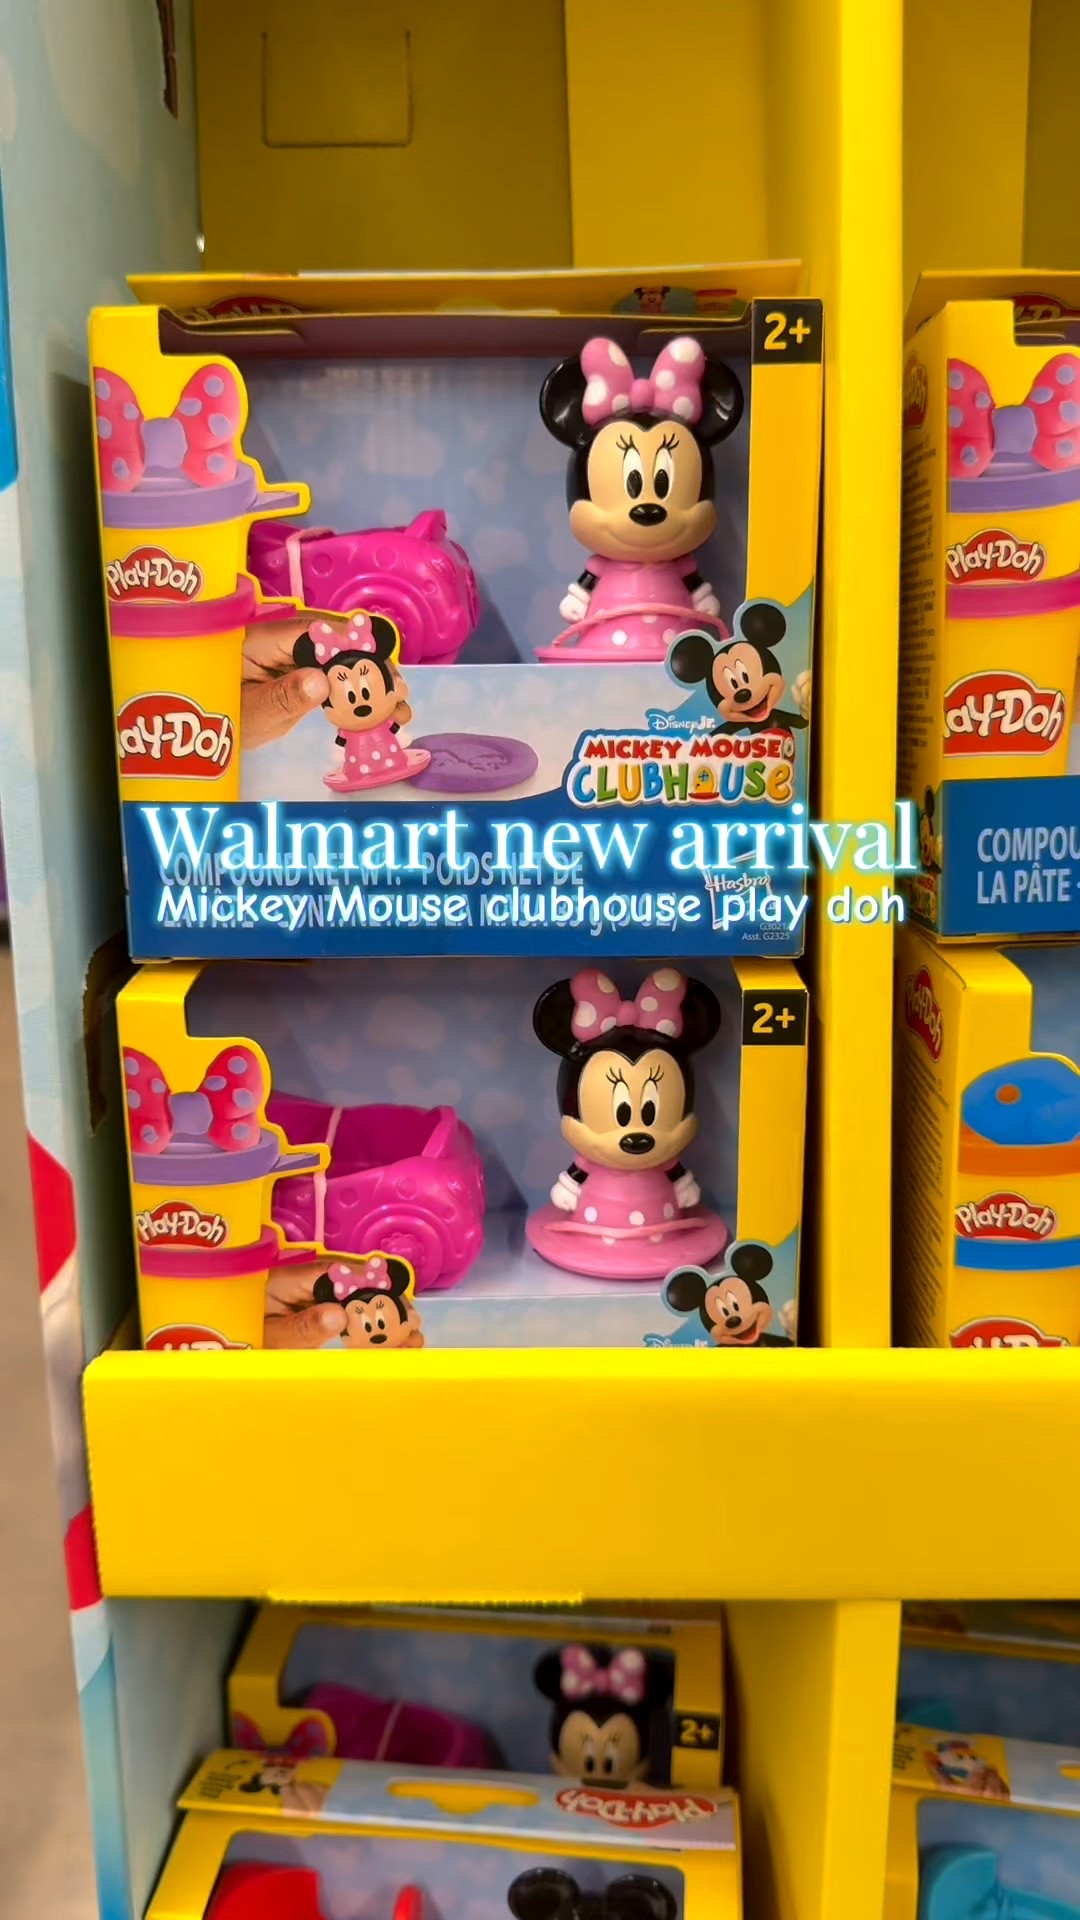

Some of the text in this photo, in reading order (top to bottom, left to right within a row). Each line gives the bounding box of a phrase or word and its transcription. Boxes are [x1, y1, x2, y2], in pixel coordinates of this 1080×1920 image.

[764, 311, 811, 350] 2+
[107, 557, 198, 596] Play-Doh
[946, 542, 1041, 579] Play-Doh
[649, 713, 698, 734] Disney
[944, 688, 1063, 742] ay-Doh
[119, 711, 231, 767] ay-Doh
[583, 737, 782, 761] MICKEY MOUSE
[422, 851, 495, 887] POIDS
[977, 870, 1008, 904] LA
[1013, 862, 1071, 903] PÂTE
[763, 932, 790, 941] G2325
[752, 1002, 796, 1034] 2+
[135, 1210, 225, 1243] Play-Doh
[955, 1202, 1053, 1235] Play-Doh
[679, 1718, 715, 1744] 2+
